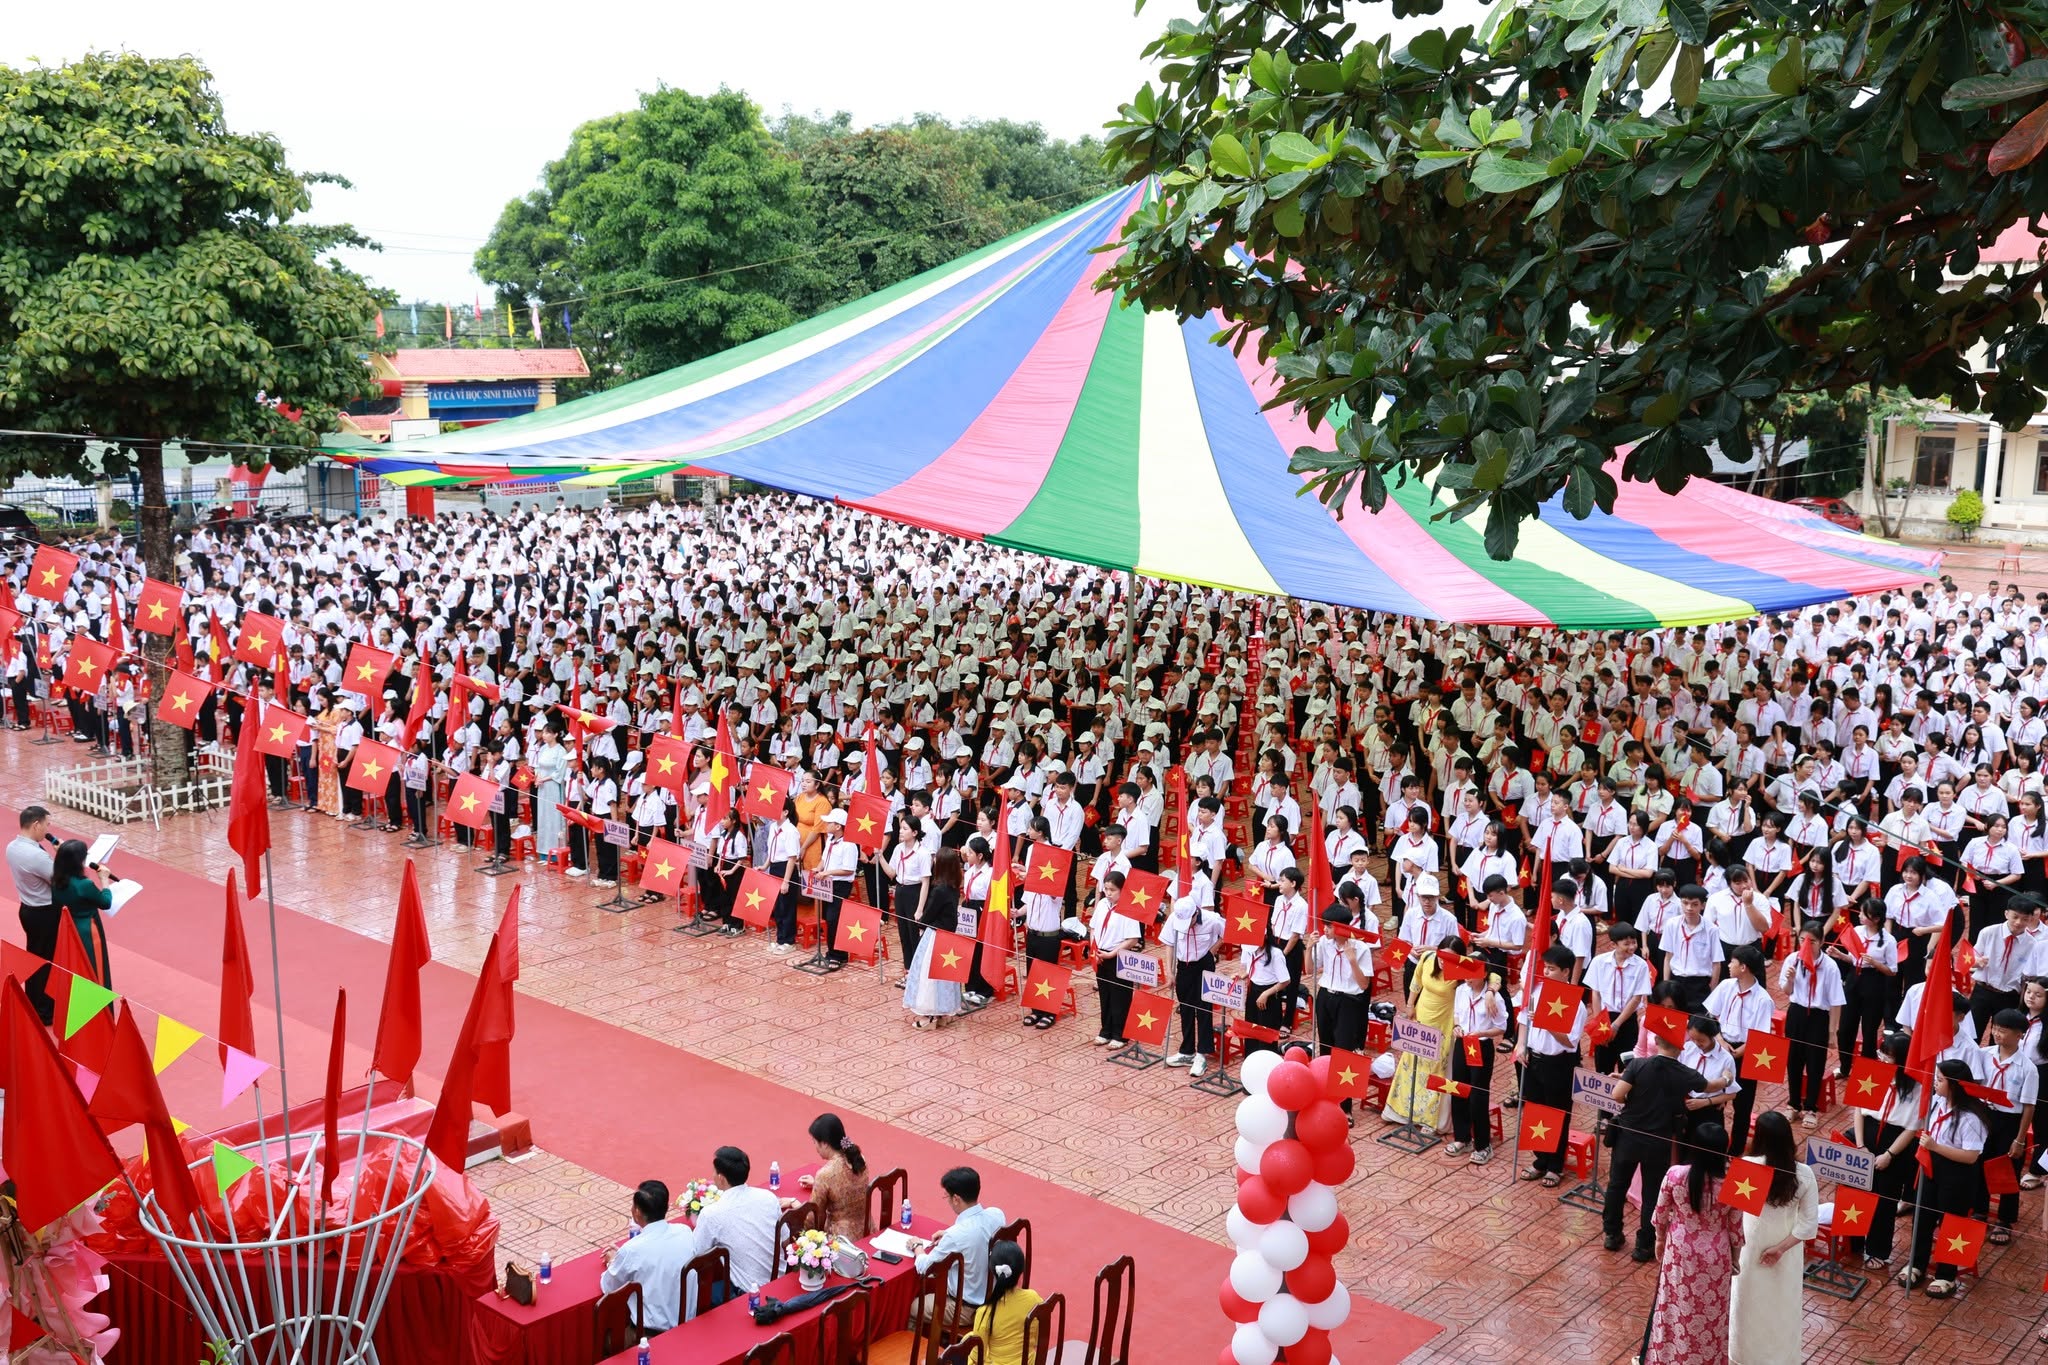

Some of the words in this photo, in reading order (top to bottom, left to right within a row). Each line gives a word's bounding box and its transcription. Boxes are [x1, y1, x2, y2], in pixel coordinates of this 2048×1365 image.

[465, 390, 482, 402] HỌC
[483, 389, 501, 400] SINH
[502, 386, 523, 399] THÂN
[962, 912, 974, 924] 9A7
[1140, 959, 1155, 972] 9A6
[1420, 1030, 1437, 1045] 9A4
[1402, 1041, 1421, 1054] Class
[1422, 1047, 1435, 1058] 9A4
[1584, 1094, 1605, 1107] Class
[1818, 1145, 1842, 1162] LỚP
[1845, 1153, 1870, 1171] 9A2
[1820, 1166, 1846, 1181] Class
[1848, 1174, 1867, 1187] 9A2
